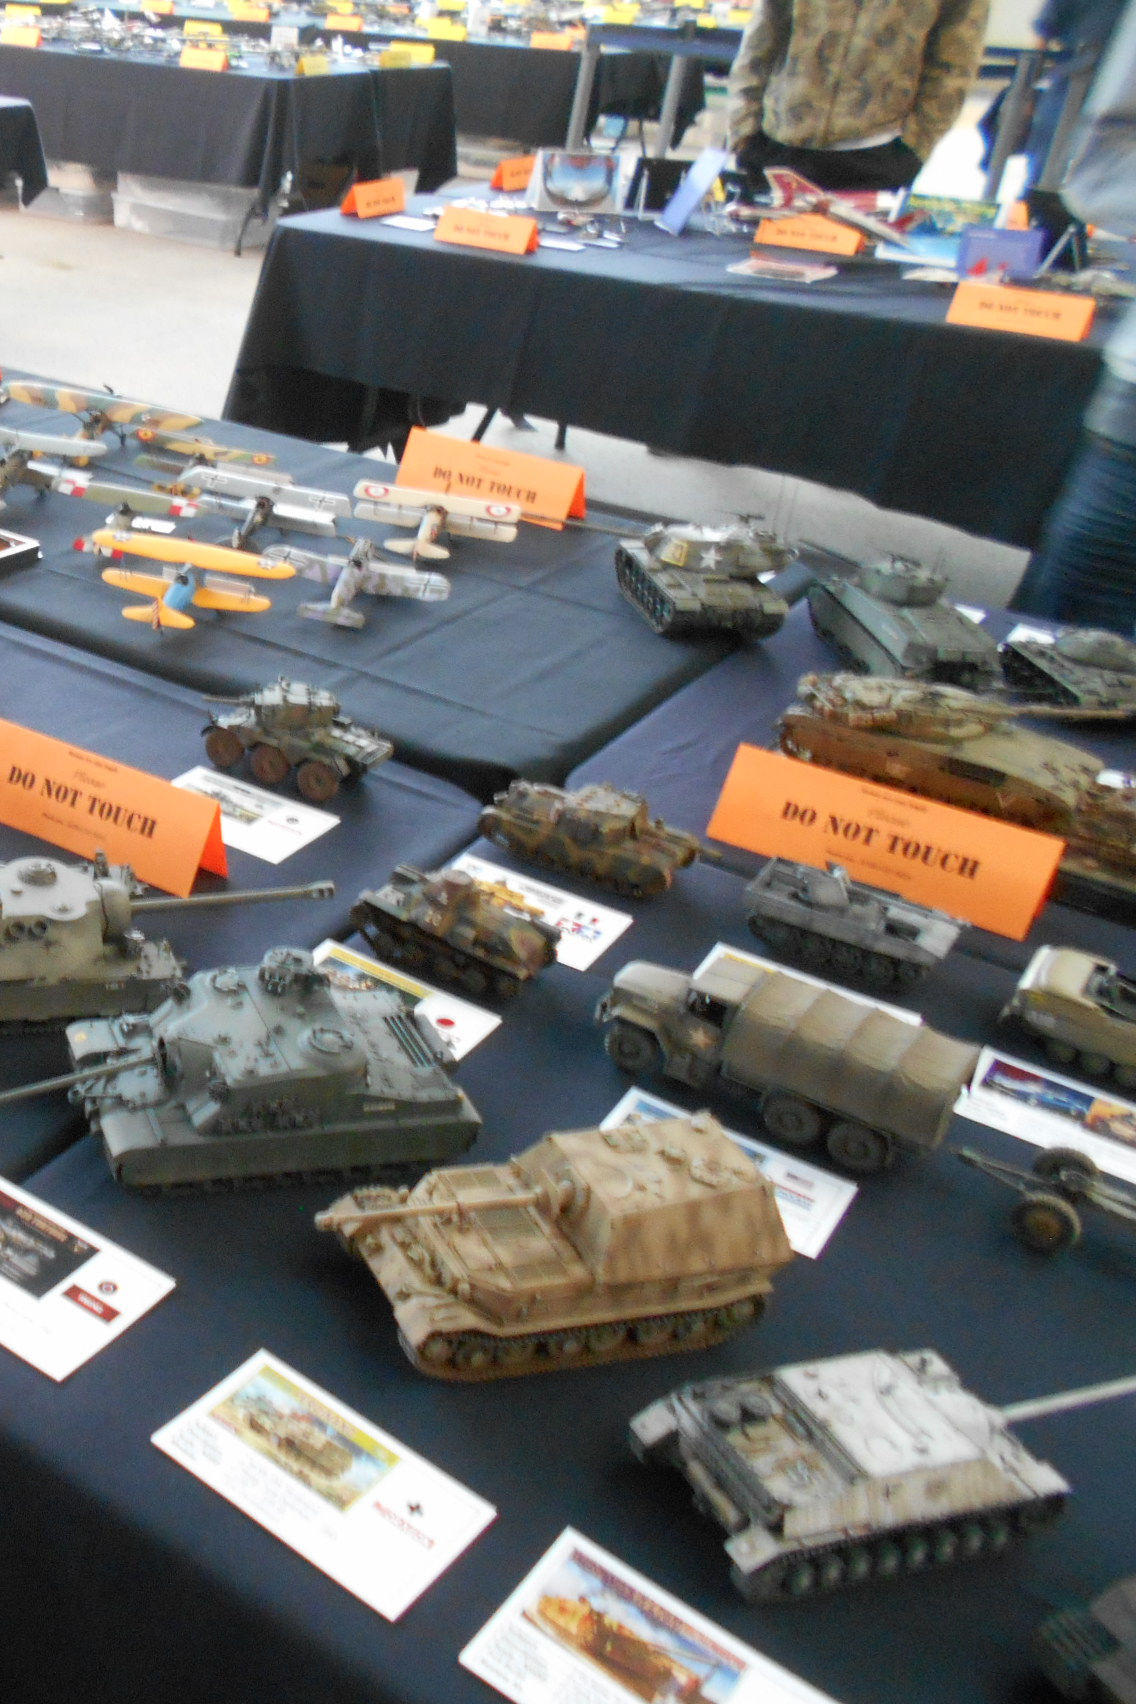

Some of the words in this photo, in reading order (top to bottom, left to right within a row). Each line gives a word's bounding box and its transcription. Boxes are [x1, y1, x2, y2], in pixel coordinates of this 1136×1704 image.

[433, 465, 453, 482] DO
[457, 472, 484, 490] NOT
[489, 481, 538, 504] TOUCH
[7, 765, 36, 791] DO
[40, 777, 84, 809] NOT
[87, 794, 158, 840] TOUCH
[780, 800, 817, 827] DO
[823, 814, 881, 847] NOT
[886, 833, 982, 882] TOUCH
